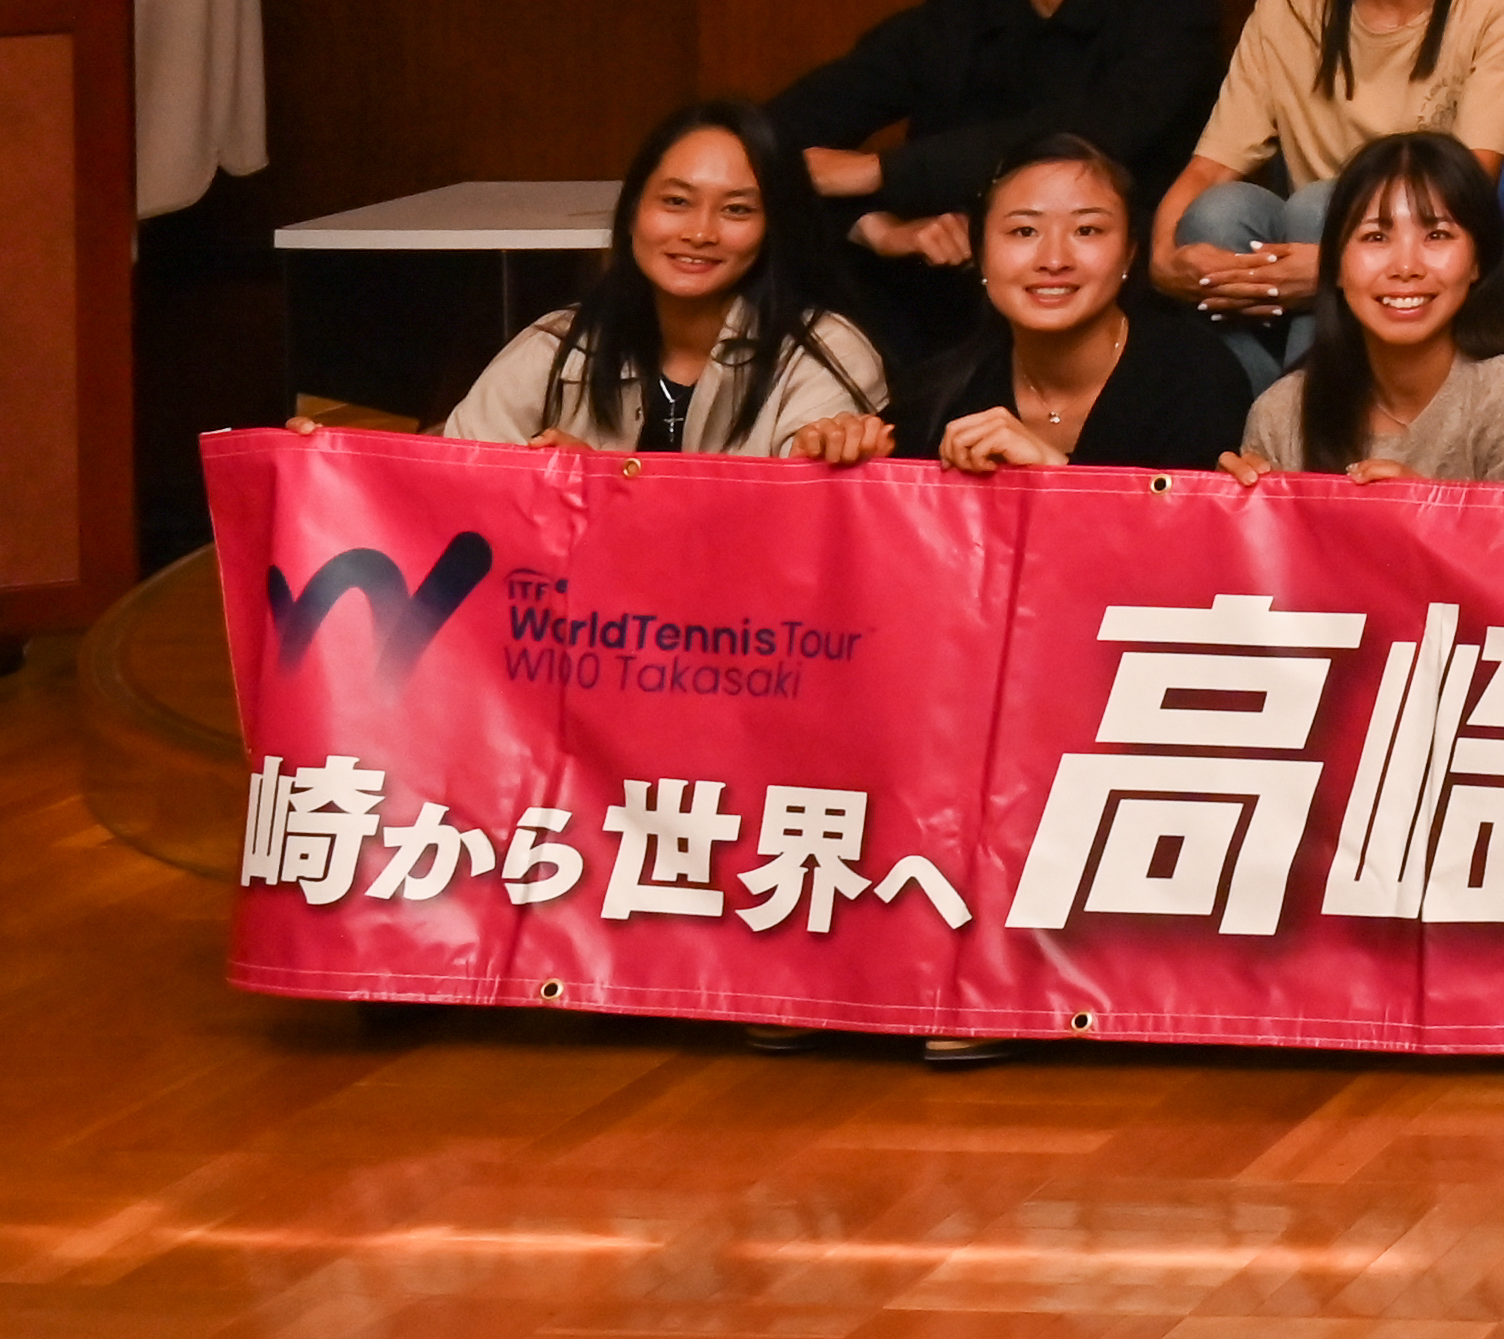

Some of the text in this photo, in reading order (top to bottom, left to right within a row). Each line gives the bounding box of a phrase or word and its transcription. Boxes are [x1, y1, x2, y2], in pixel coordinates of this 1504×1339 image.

[617, 653, 803, 701] Takasaki
[240, 755, 972, 934] 崎から世界へ
